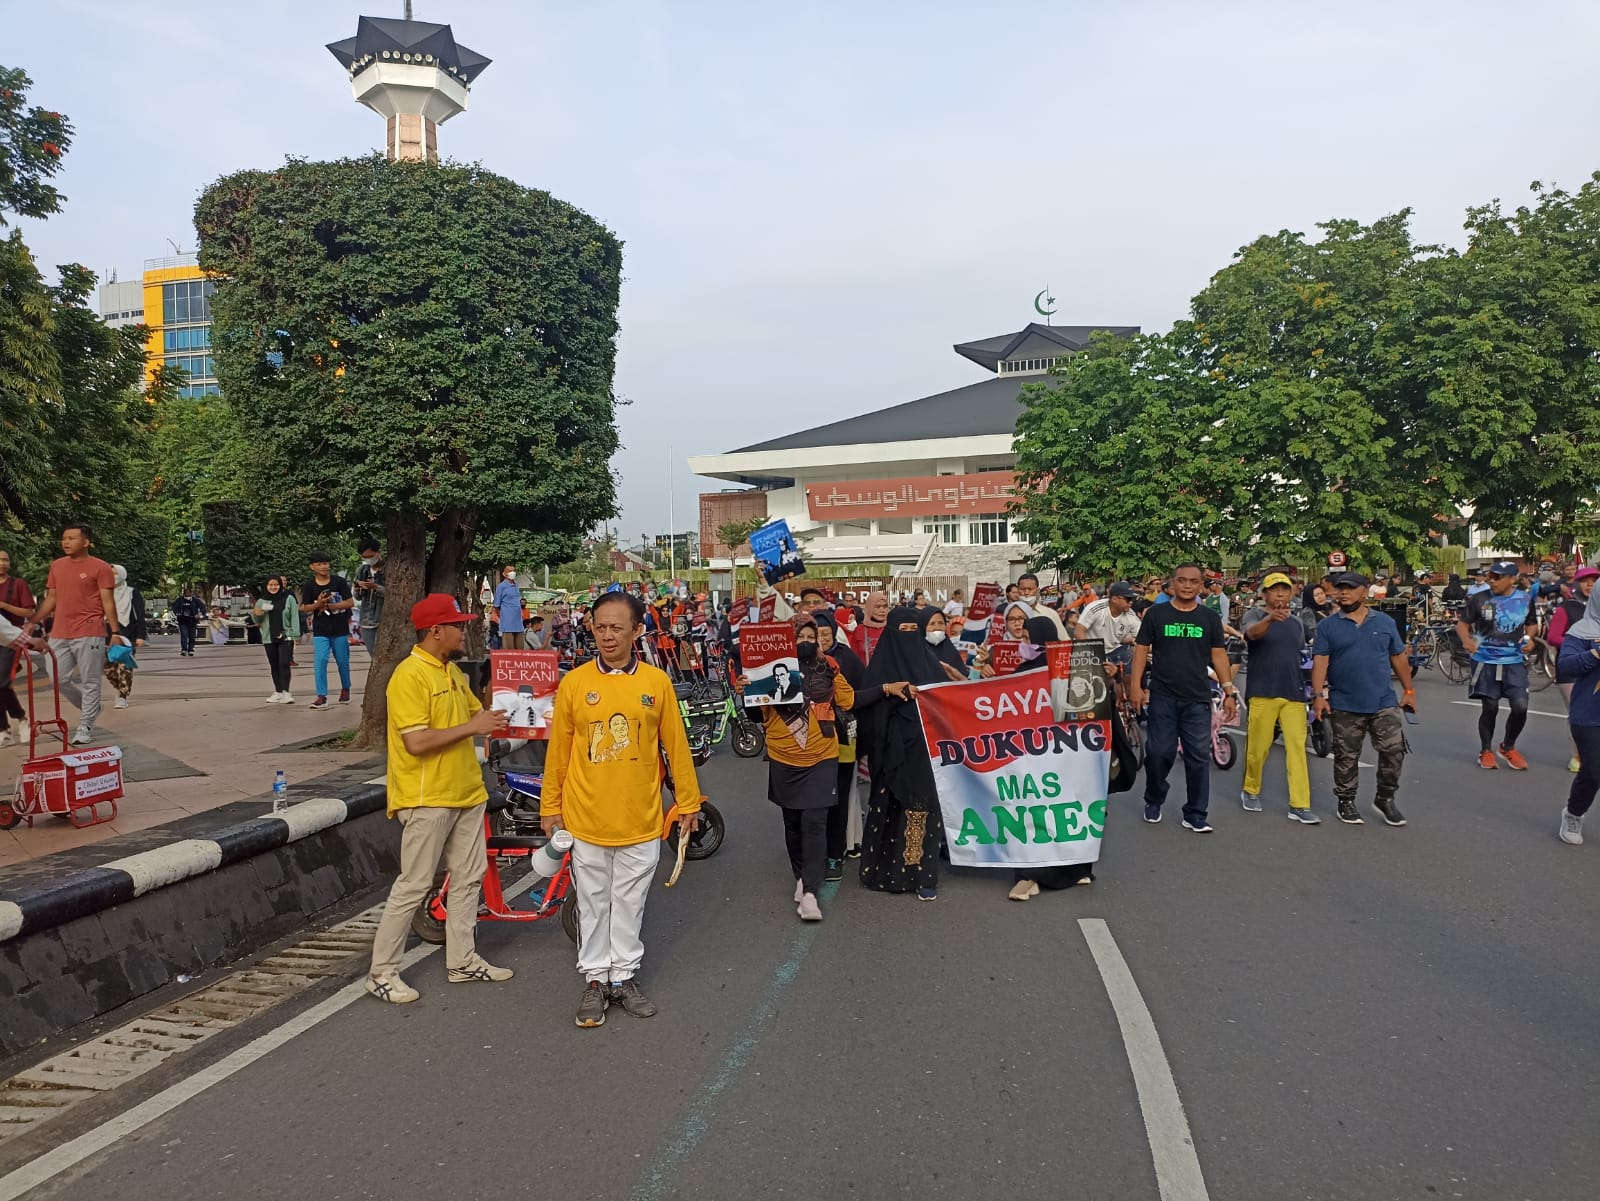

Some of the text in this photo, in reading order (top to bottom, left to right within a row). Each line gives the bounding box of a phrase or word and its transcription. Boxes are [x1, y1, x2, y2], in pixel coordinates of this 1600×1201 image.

[746, 633, 787, 643] PEMIMPIN
[742, 642, 793, 652] FATONAH
[1058, 650, 1095, 660] PEMIMPIN
[498, 659, 552, 669] PEMIMPIN
[1055, 656, 1101, 669] SHIDDIQ
[496, 668, 555, 682] BERANI
[974, 687, 1053, 721] SAYA
[936, 722, 1107, 767] DUKUNG
[73, 750, 115, 761] Yakult
[996, 772, 1062, 801] MAS
[954, 800, 1107, 846] ANIES
